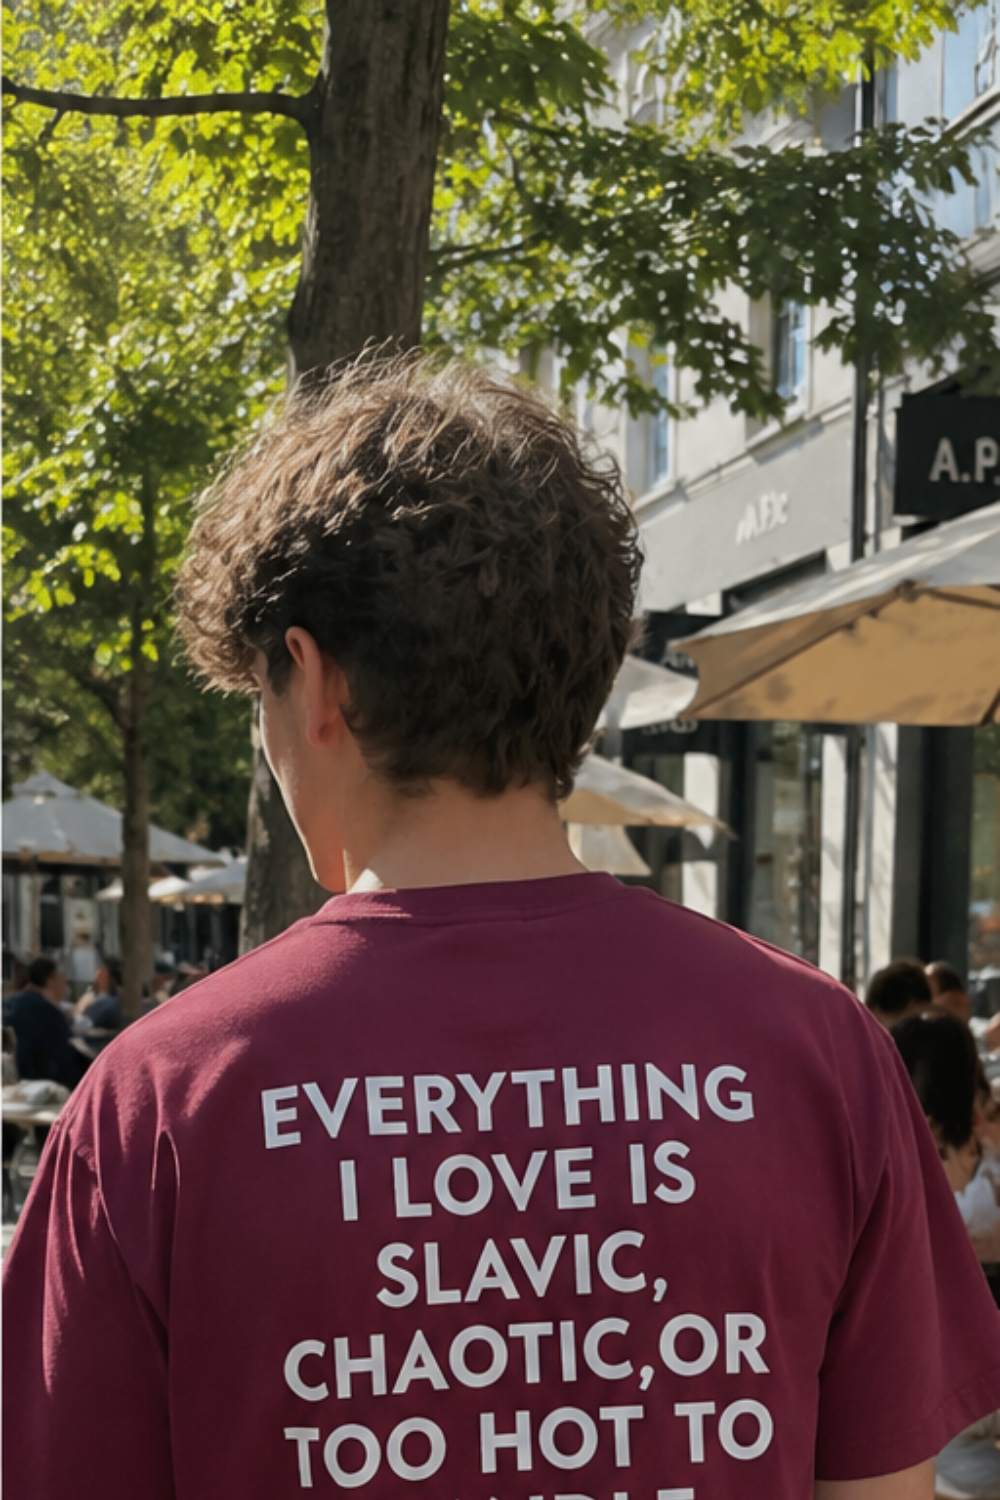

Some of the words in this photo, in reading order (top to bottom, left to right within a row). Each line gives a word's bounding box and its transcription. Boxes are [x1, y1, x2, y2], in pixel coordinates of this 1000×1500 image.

[261, 1062, 755, 1149] EVERYTHING
[340, 1159, 358, 1221] I
[392, 1147, 596, 1218] LOVE
[629, 1140, 696, 1204] IS
[376, 1230, 667, 1308] SLAVIC,
[284, 1417, 446, 1488] TOO
[480, 1405, 644, 1474] HOT
[674, 1399, 773, 1463] TO
